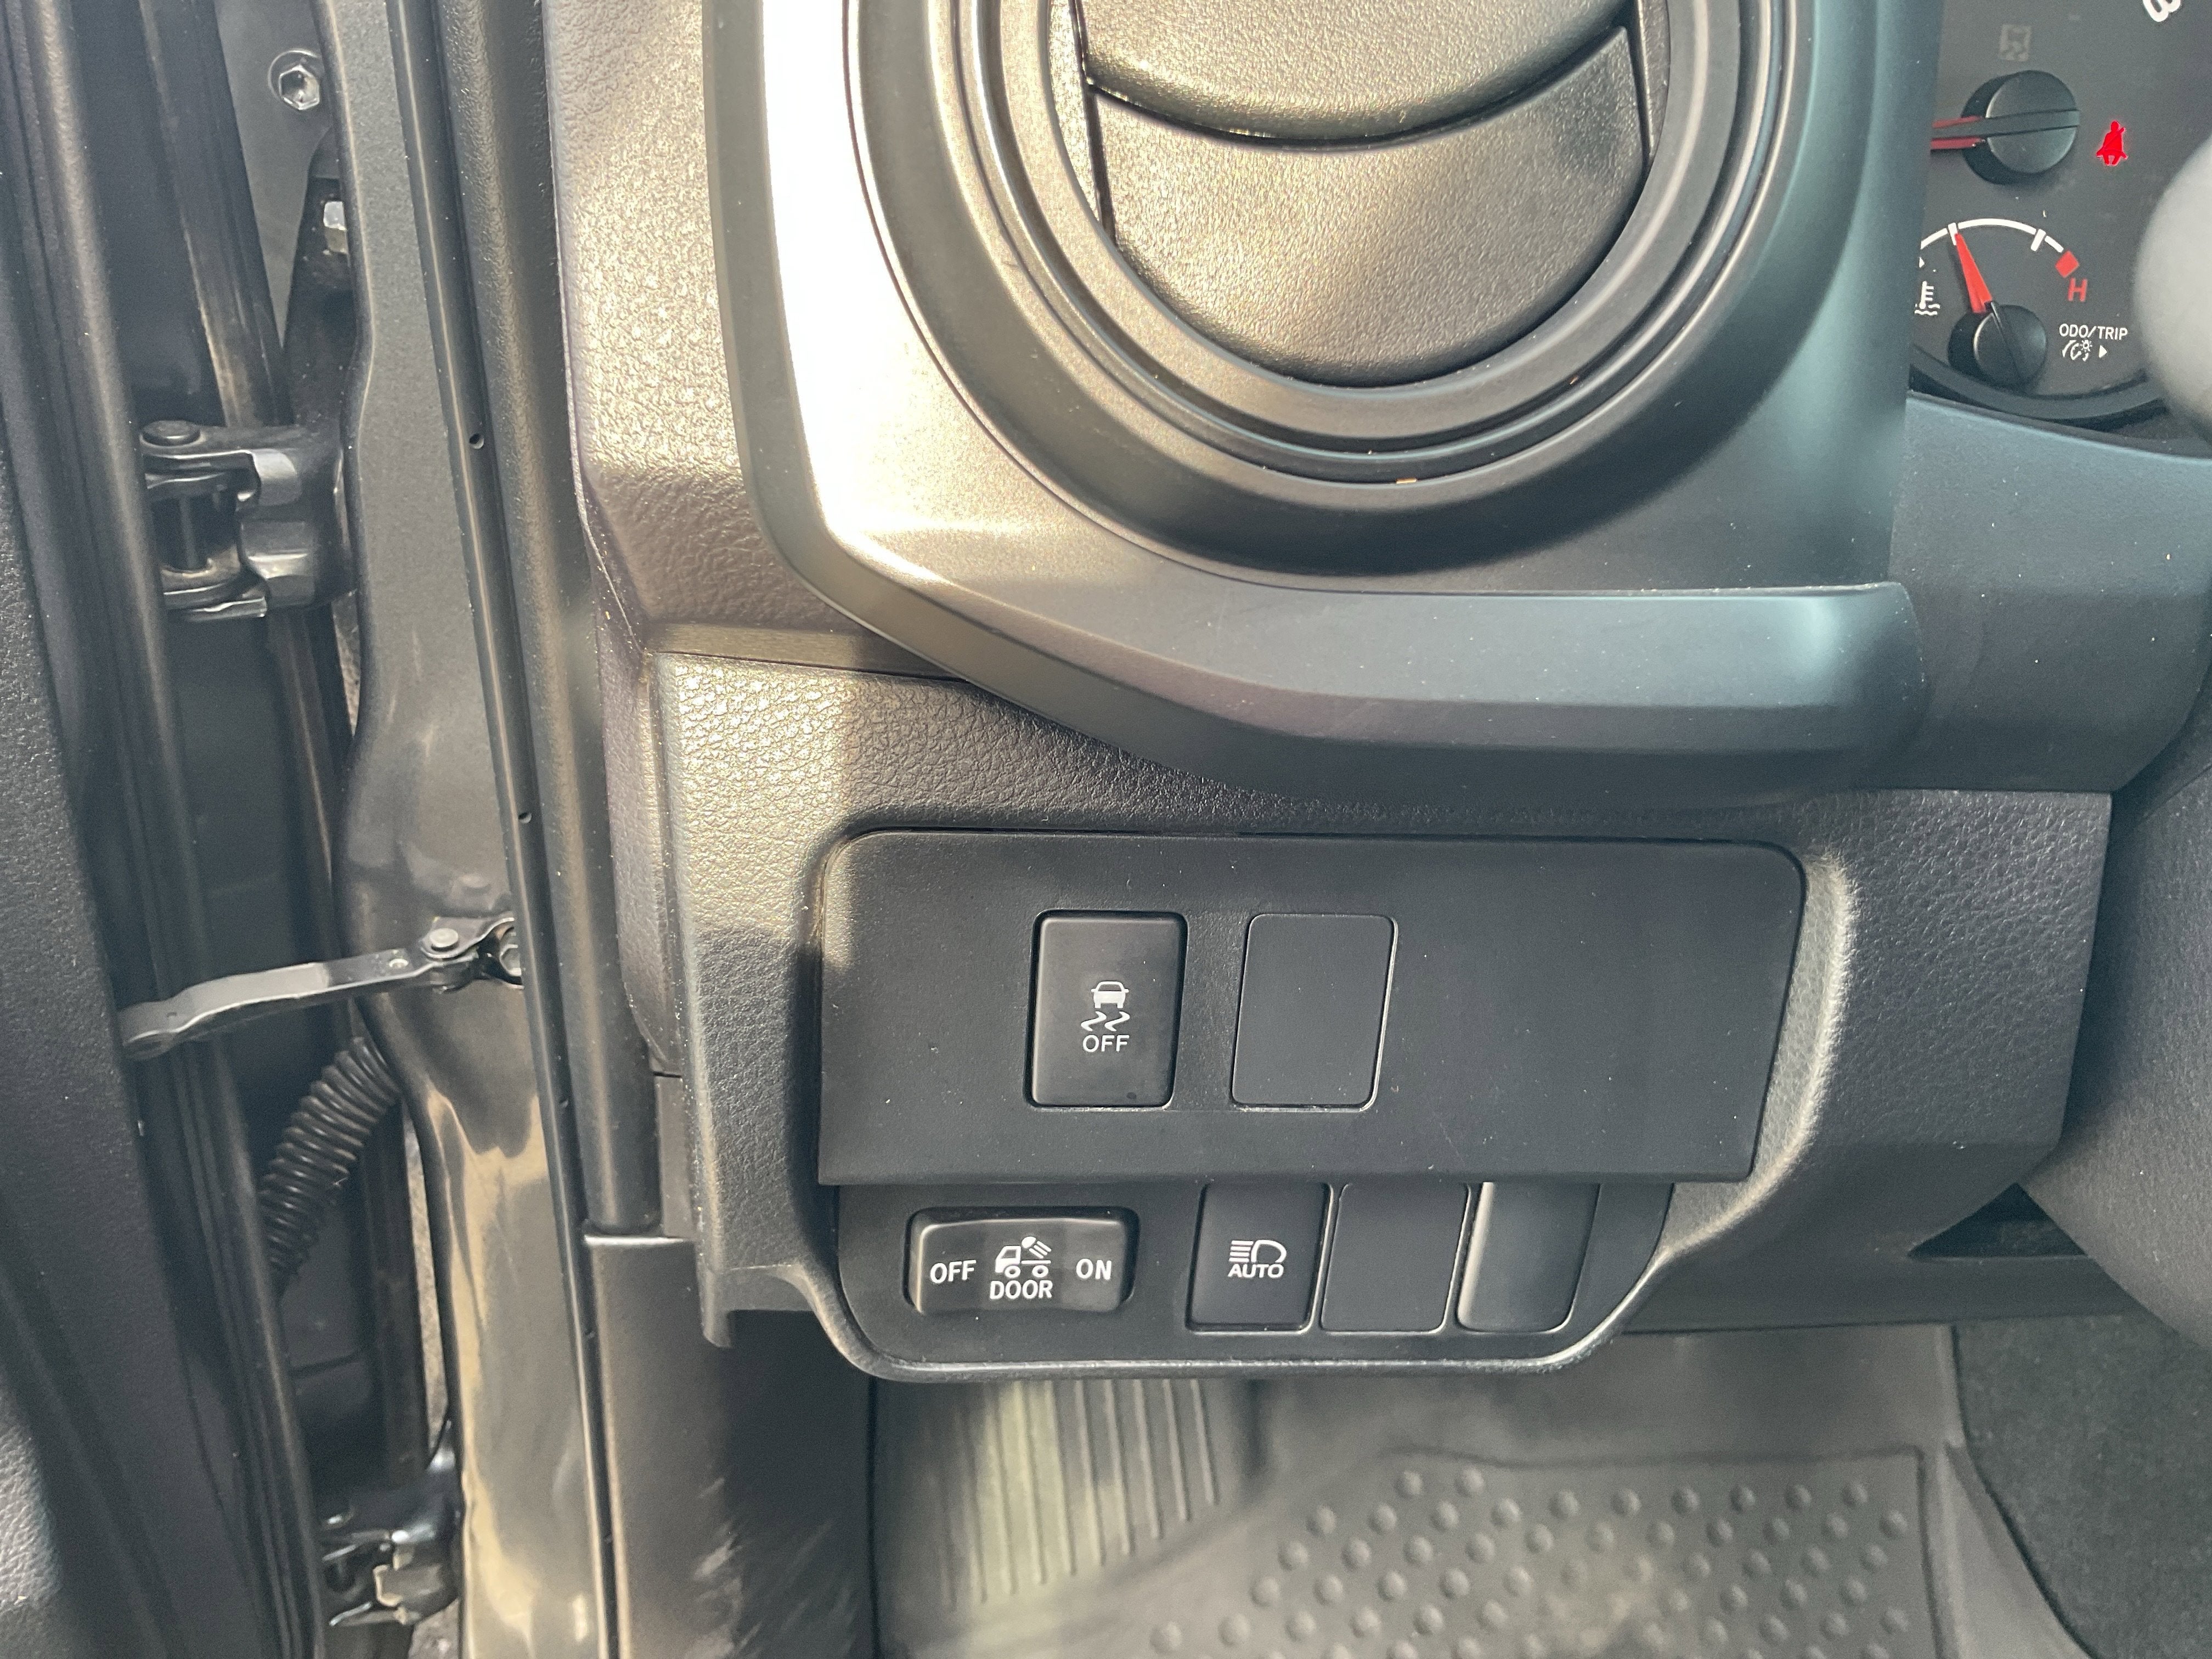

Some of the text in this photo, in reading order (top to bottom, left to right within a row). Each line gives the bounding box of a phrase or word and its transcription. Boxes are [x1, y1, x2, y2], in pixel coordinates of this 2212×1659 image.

[2068, 278, 2087, 301] H
[2059, 323, 2128, 340] ODO/TRIP
[1082, 1035, 1130, 1052] OFF
[930, 1258, 1113, 1284] OFF ON
[1228, 1263, 1284, 1278] AUTO
[989, 1280, 1053, 1300] DOOR
